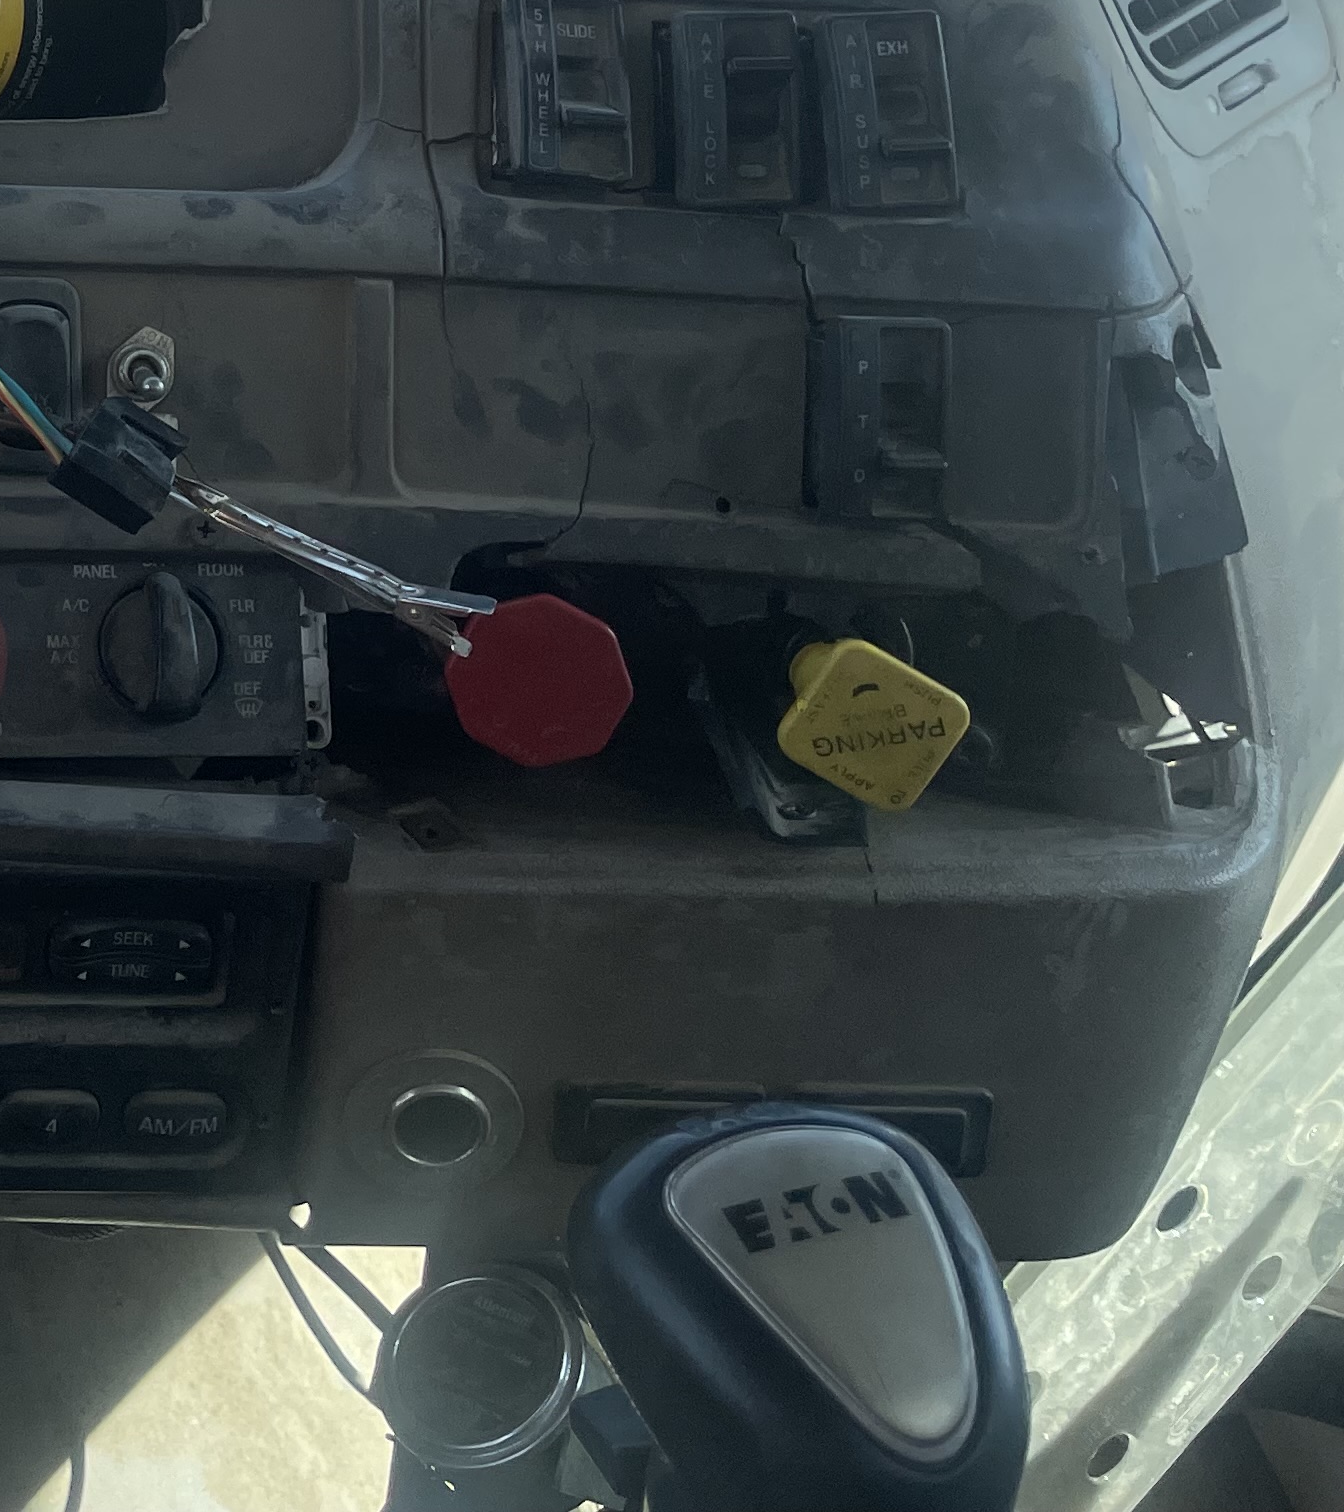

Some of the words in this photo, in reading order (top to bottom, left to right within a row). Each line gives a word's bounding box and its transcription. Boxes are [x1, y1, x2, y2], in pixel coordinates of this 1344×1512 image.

[534, 9, 546, 53] 5TH
[557, 23, 596, 39] SLIDE
[877, 40, 909, 57] EXH
[701, 32, 714, 99] AXLE
[536, 73, 551, 153] WHEEL
[845, 34, 864, 89] AIR
[855, 115, 871, 189] SUSP
[704, 121, 717, 185] LOCK
[73, 565, 118, 579] PANEL
[62, 599, 89, 613] A/C
[229, 599, 256, 613] FLR
[46, 635, 80, 649] MAX
[49, 650, 80, 665] A/C
[244, 650, 272, 664] DEF
[234, 682, 262, 696] DEF
[811, 717, 946, 758] PARKING
[829, 763, 876, 792] APPLY
[113, 931, 153, 946] SEEK
[111, 963, 150, 978] TUNE
[45, 1118, 58, 1134] 4
[139, 1115, 218, 1136] AM/FM
[722, 1170, 912, 1254] EATON
